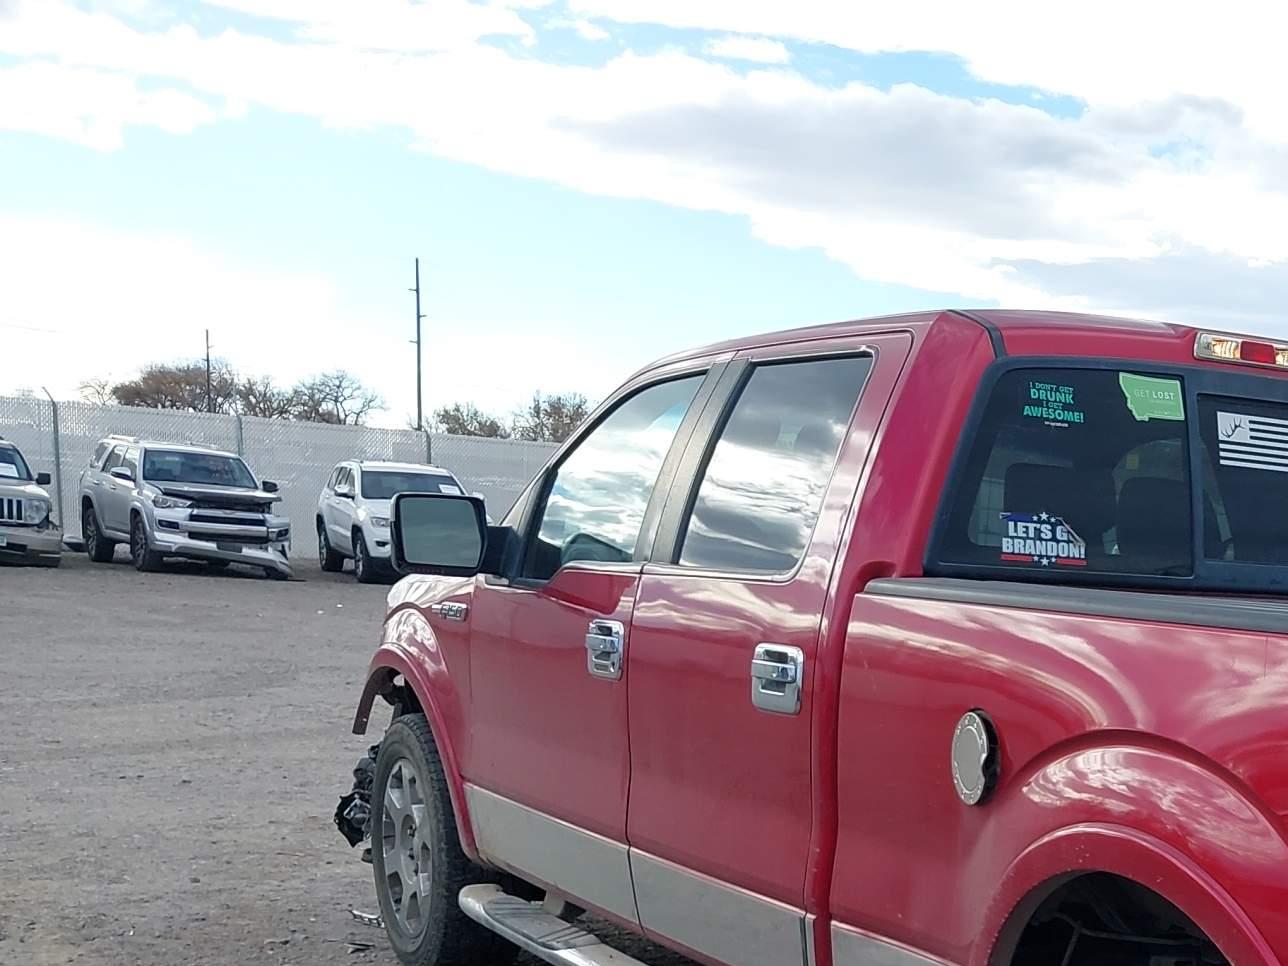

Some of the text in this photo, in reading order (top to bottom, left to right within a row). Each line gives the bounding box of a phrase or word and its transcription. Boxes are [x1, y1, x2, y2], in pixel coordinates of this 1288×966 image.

[1030, 388, 1074, 404] DRUNK
[1152, 391, 1175, 400] LOST
[1023, 405, 1084, 423] AWESOME!
[1008, 520, 1053, 540] LET'S
[1001, 536, 1086, 559] BRANDON!
